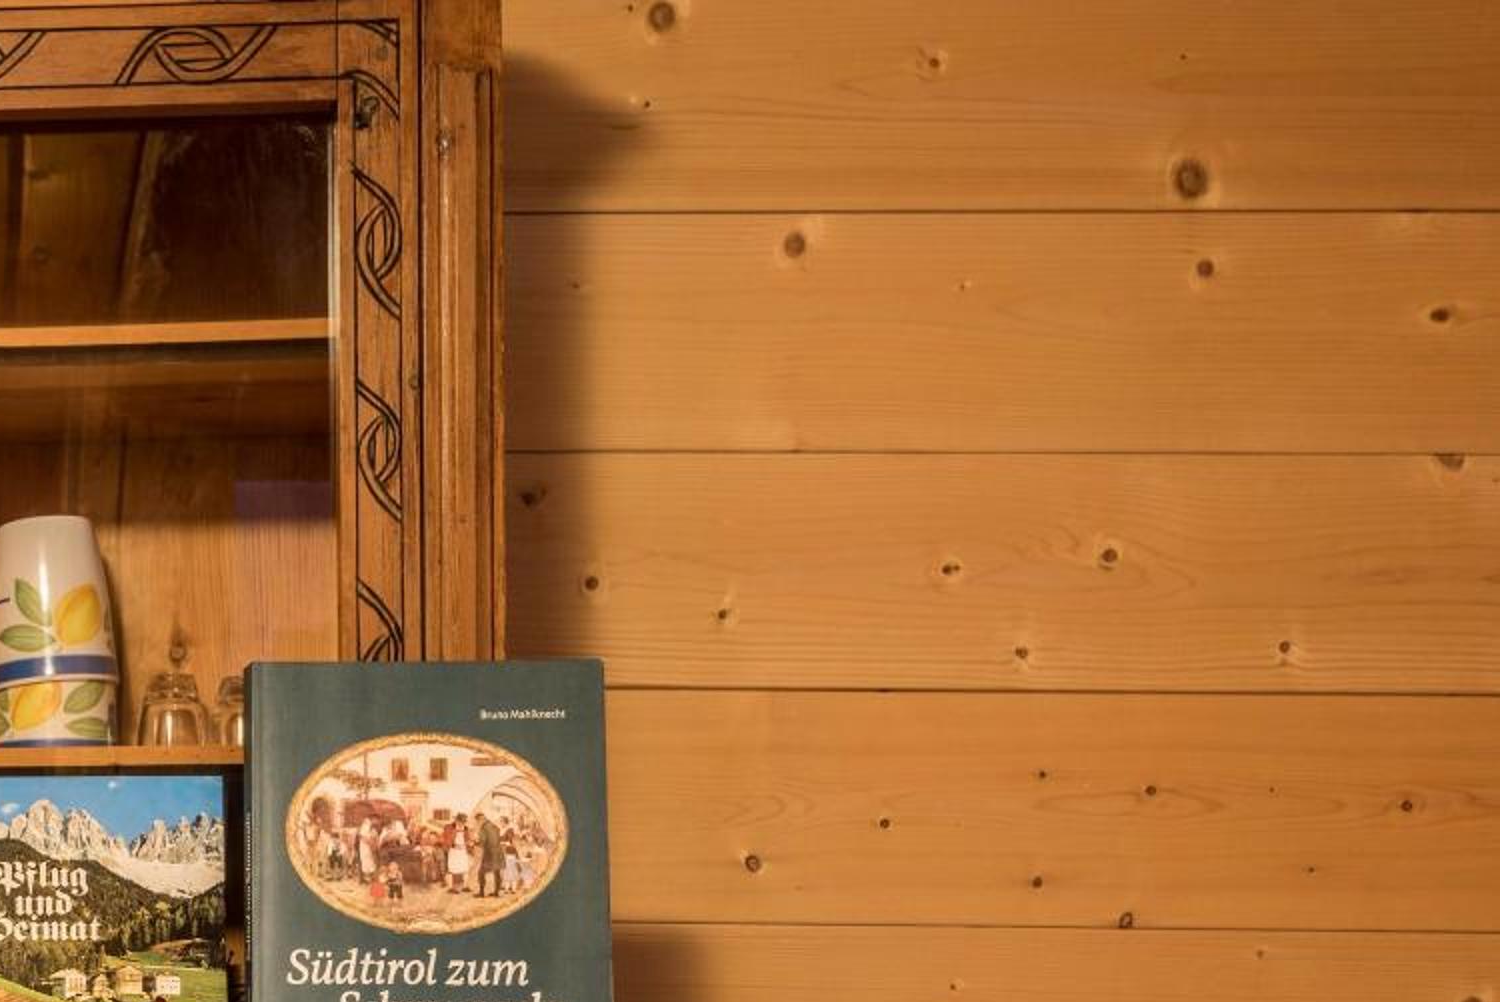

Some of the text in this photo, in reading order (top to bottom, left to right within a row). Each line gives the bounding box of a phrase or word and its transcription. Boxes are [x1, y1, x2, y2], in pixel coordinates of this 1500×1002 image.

[15, 890, 73, 915] und
[286, 948, 529, 986] Südtirol zum
